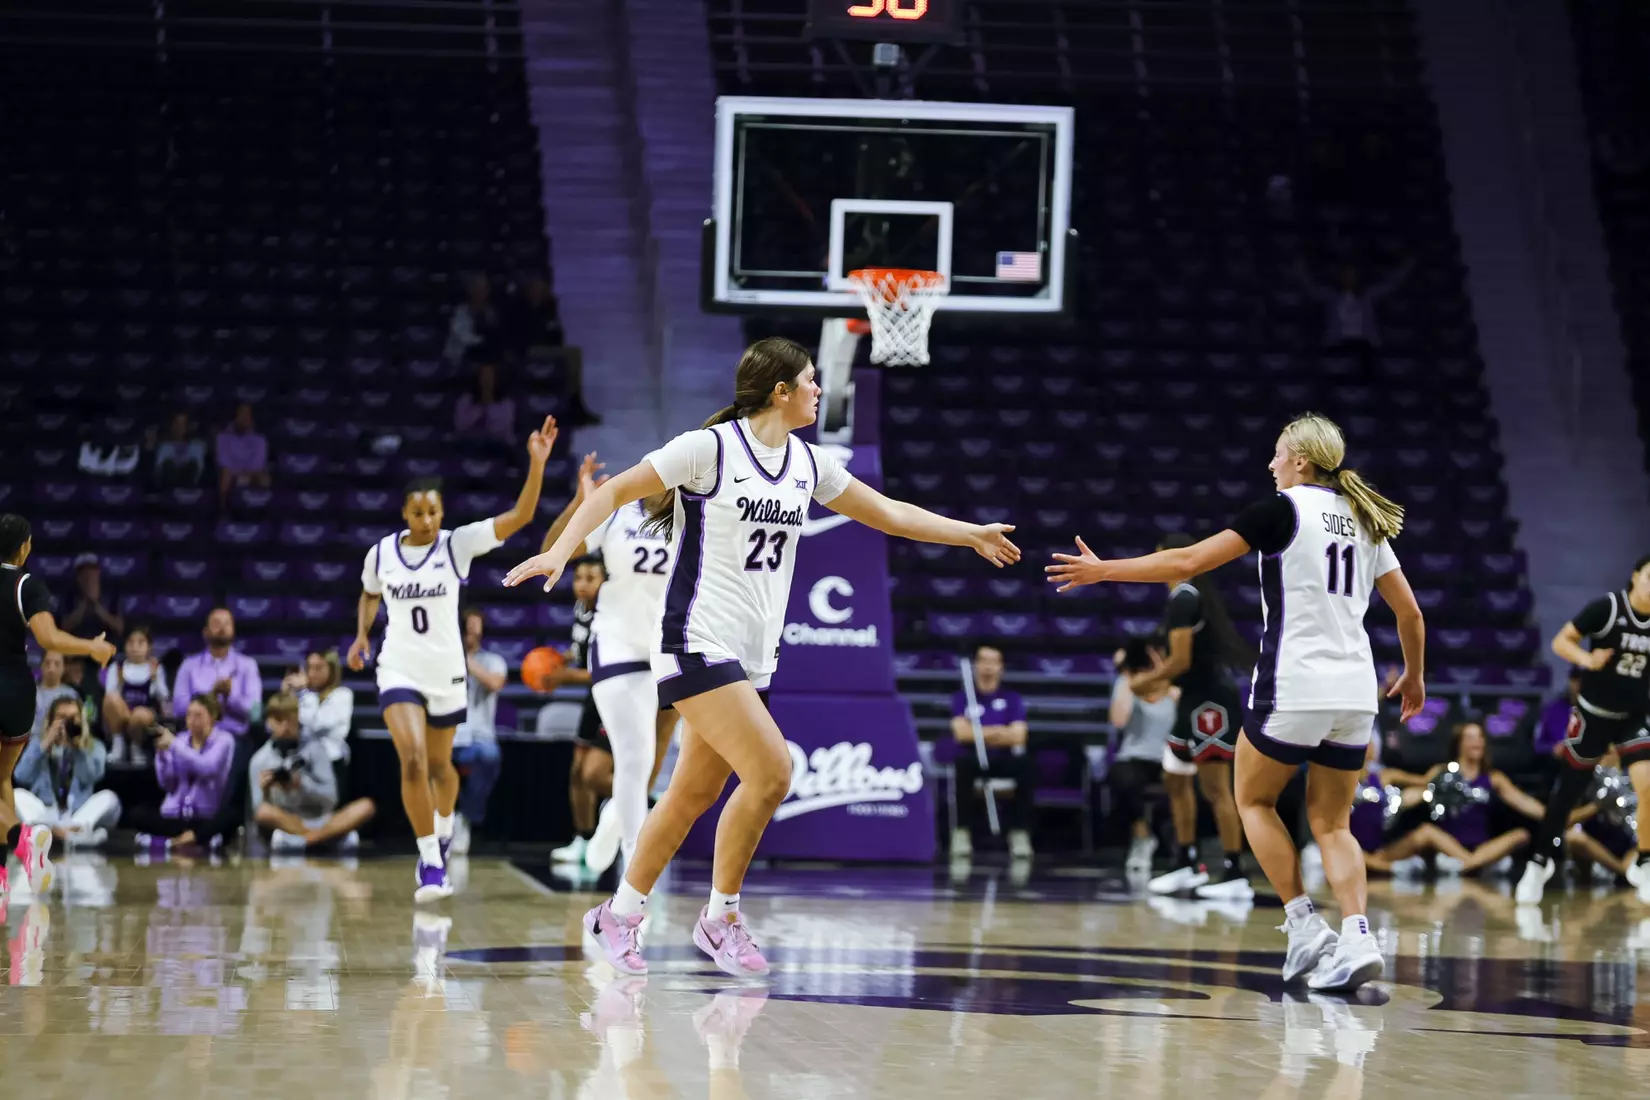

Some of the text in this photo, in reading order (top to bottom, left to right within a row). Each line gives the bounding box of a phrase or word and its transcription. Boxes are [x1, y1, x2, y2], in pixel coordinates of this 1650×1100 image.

[1322, 512, 1356, 537] SIDES
[633, 546, 669, 575] 22
[744, 528, 788, 572] 23
[1325, 541, 1355, 597] 11
[387, 583, 447, 599] Wildcats
[411, 606, 429, 634] 0
[1620, 632, 1650, 654] TRO
